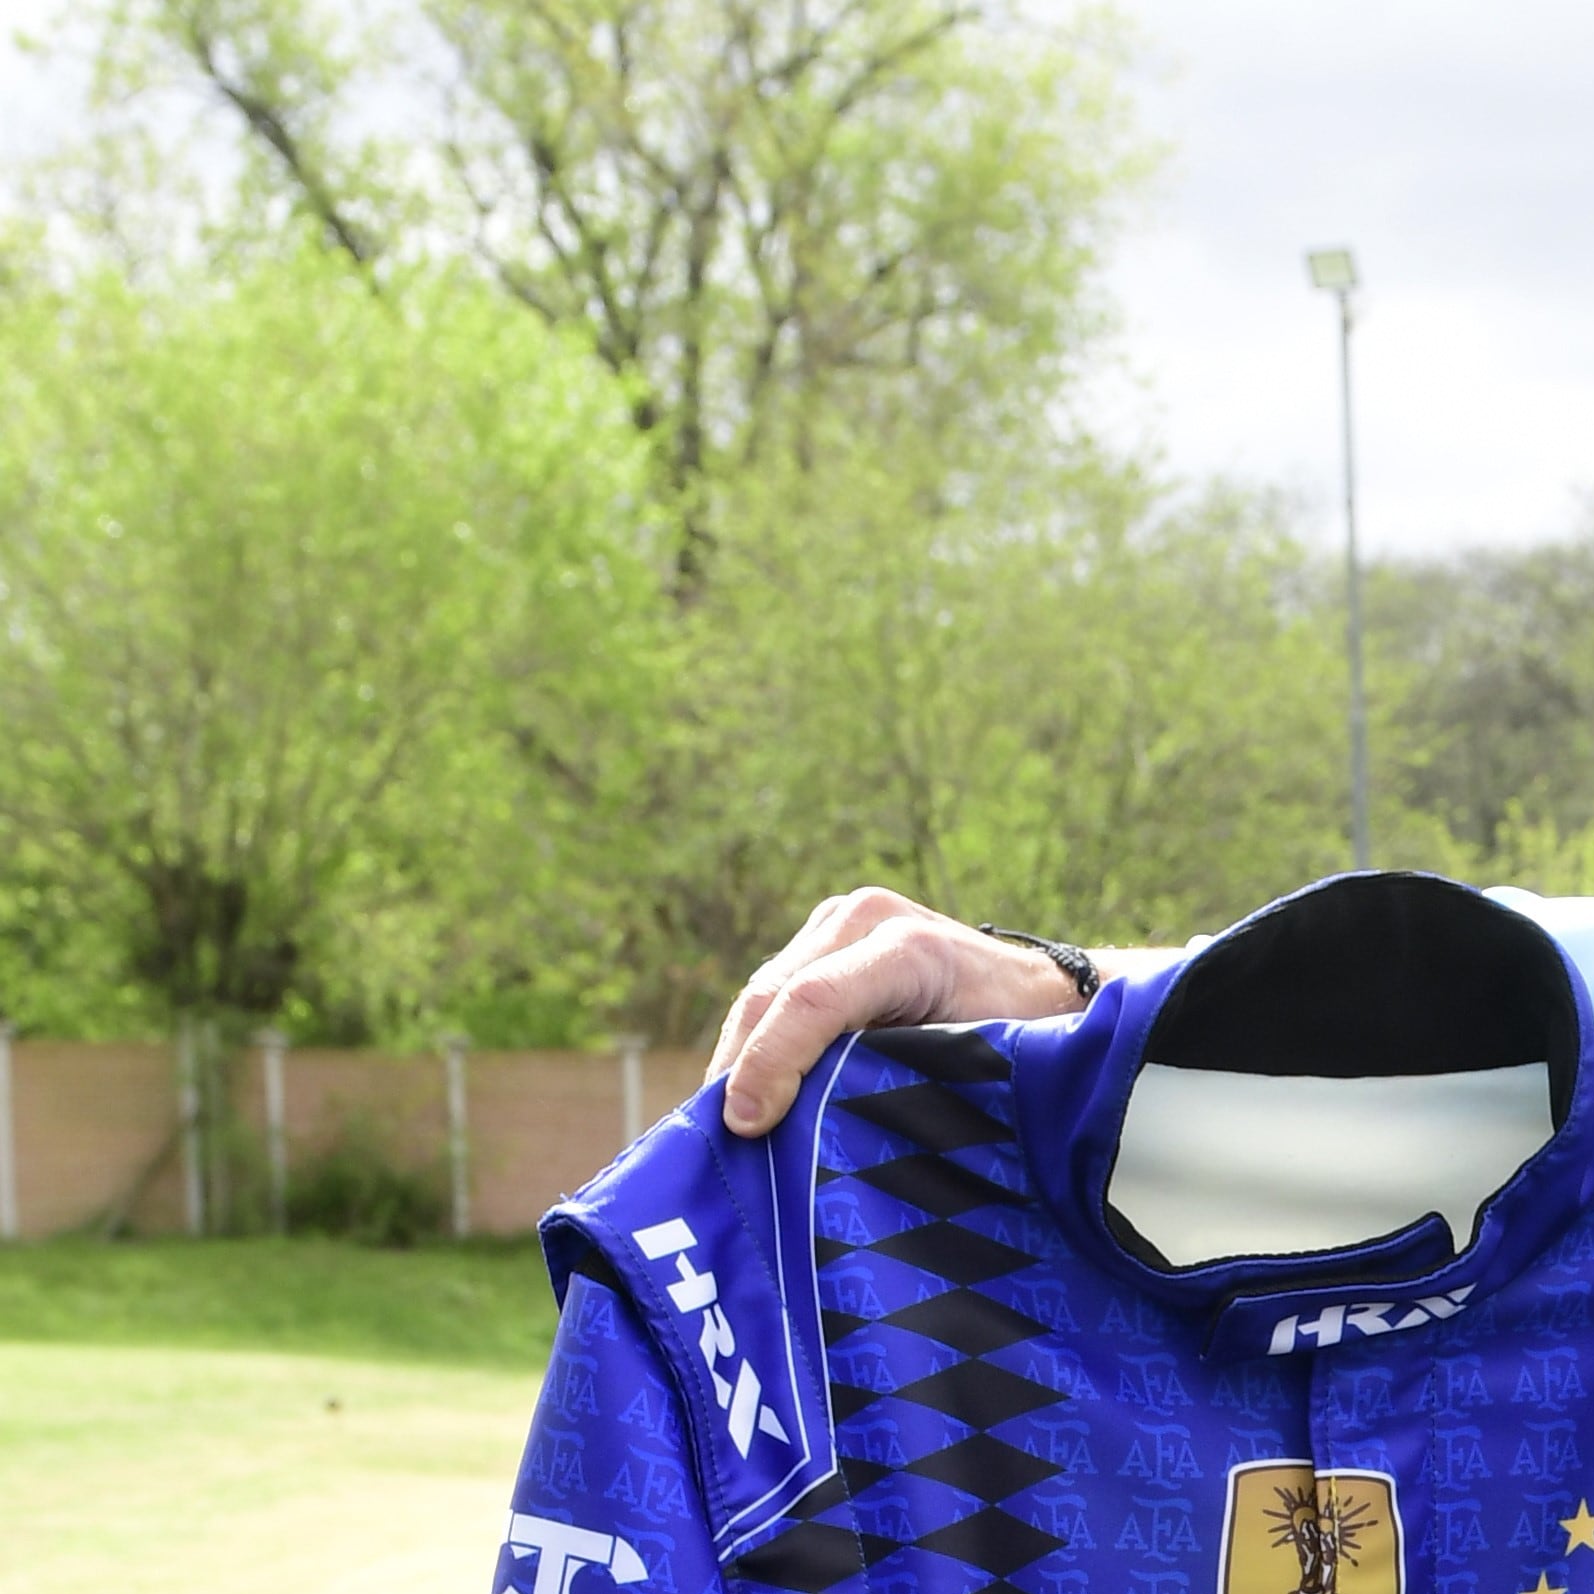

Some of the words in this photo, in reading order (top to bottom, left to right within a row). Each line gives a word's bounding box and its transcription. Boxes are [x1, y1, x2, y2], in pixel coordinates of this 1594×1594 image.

[631, 1217, 790, 1460] HRX
[1267, 1282, 1478, 1355] HRX
[1510, 1347, 1587, 1407] AFA
[1119, 1422, 1196, 1487] AFA
[1510, 1416, 1585, 1479] AFA
[1115, 1495, 1192, 1560] AFA
